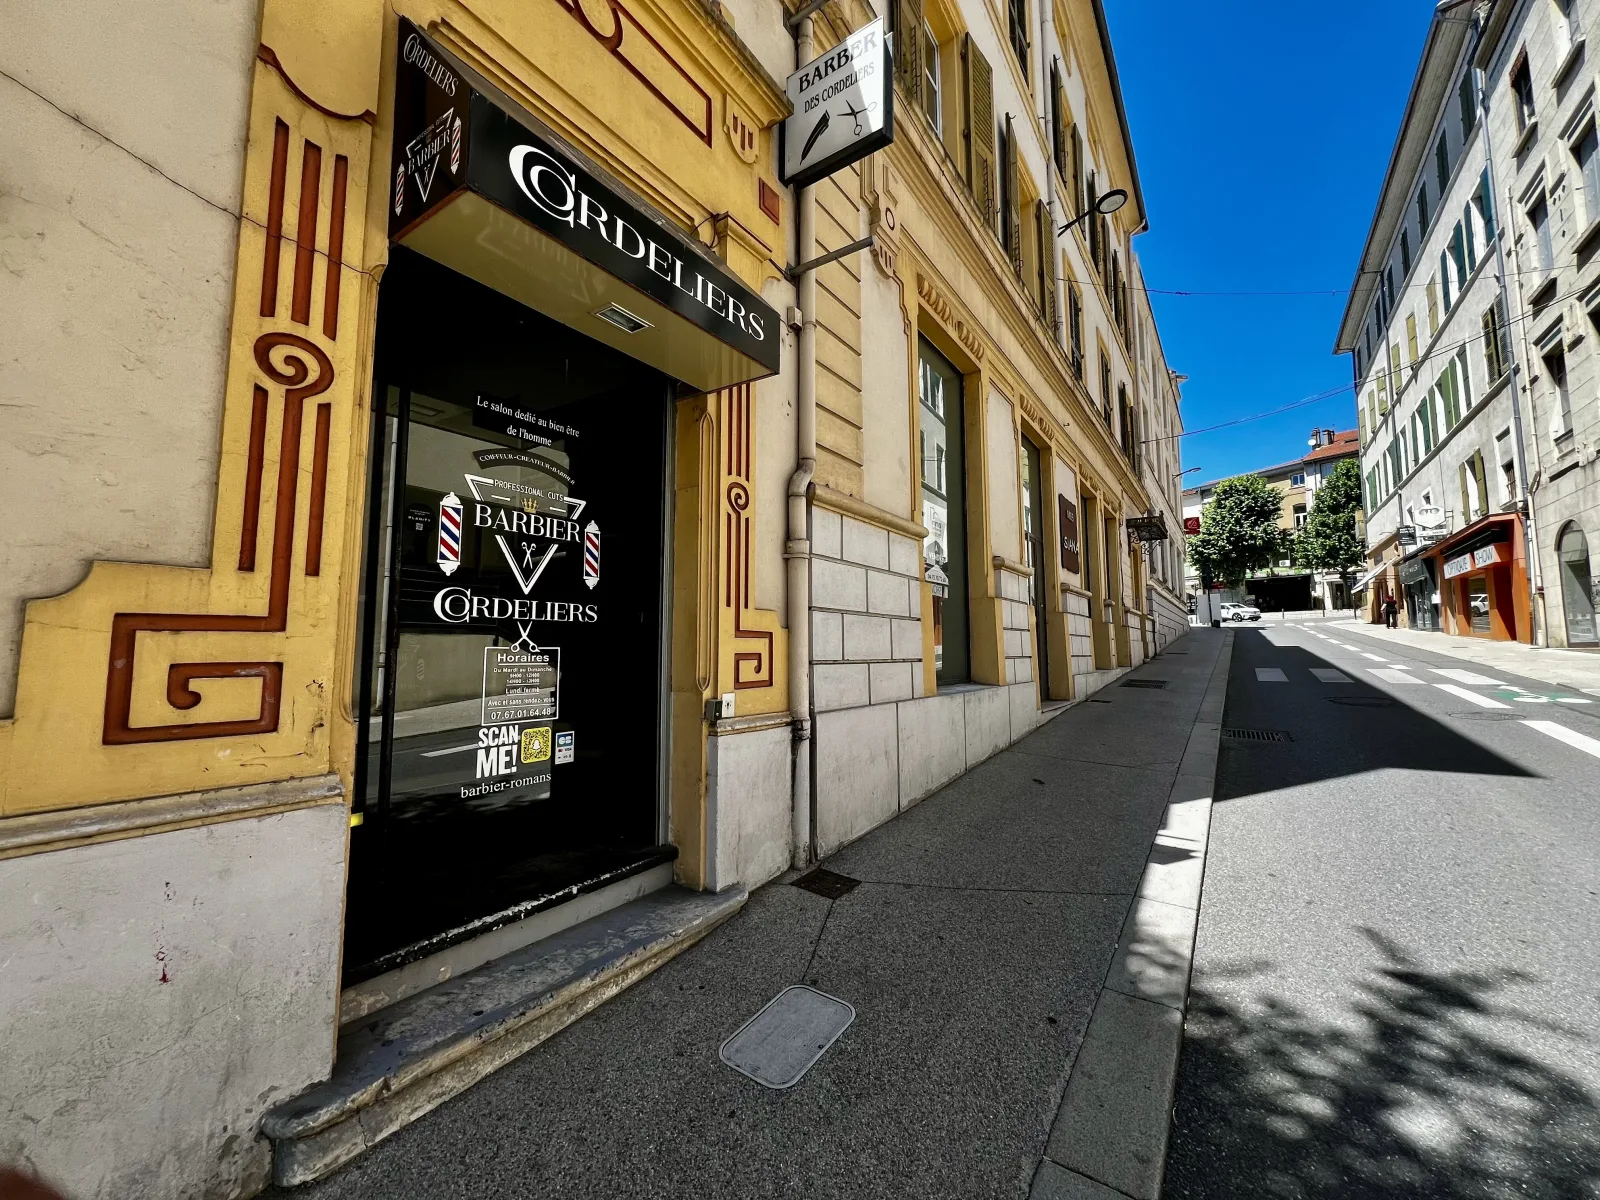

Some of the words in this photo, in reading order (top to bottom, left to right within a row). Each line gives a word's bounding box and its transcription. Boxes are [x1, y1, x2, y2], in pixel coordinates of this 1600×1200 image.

[403, 33, 459, 97] CORDELIERS
[799, 31, 877, 94] BARBER
[804, 93, 820, 113] DES
[821, 61, 875, 102] CORDELIERS
[408, 128, 451, 175] BARBIER
[508, 144, 765, 341] CORDELIERS
[476, 395, 489, 408] Le
[490, 403, 513, 416] salon
[538, 418, 547, 427] au
[549, 419, 565, 433] bien
[506, 425, 517, 435] de
[494, 479, 544, 498] PROFESSIONAL
[547, 491, 565, 502] CUTS
[474, 503, 581, 543] BARBIER
[1447, 557, 1468, 576] OPTIQUE
[1475, 545, 1493, 566] SHOW
[433, 586, 598, 623] CORDELIERS
[497, 653, 550, 662] Horaires
[491, 707, 551, 720] 07.67.01.64.48
[478, 725, 519, 748] SCAN
[476, 745, 518, 779] ME!
[460, 773, 552, 798] barbier-romans
